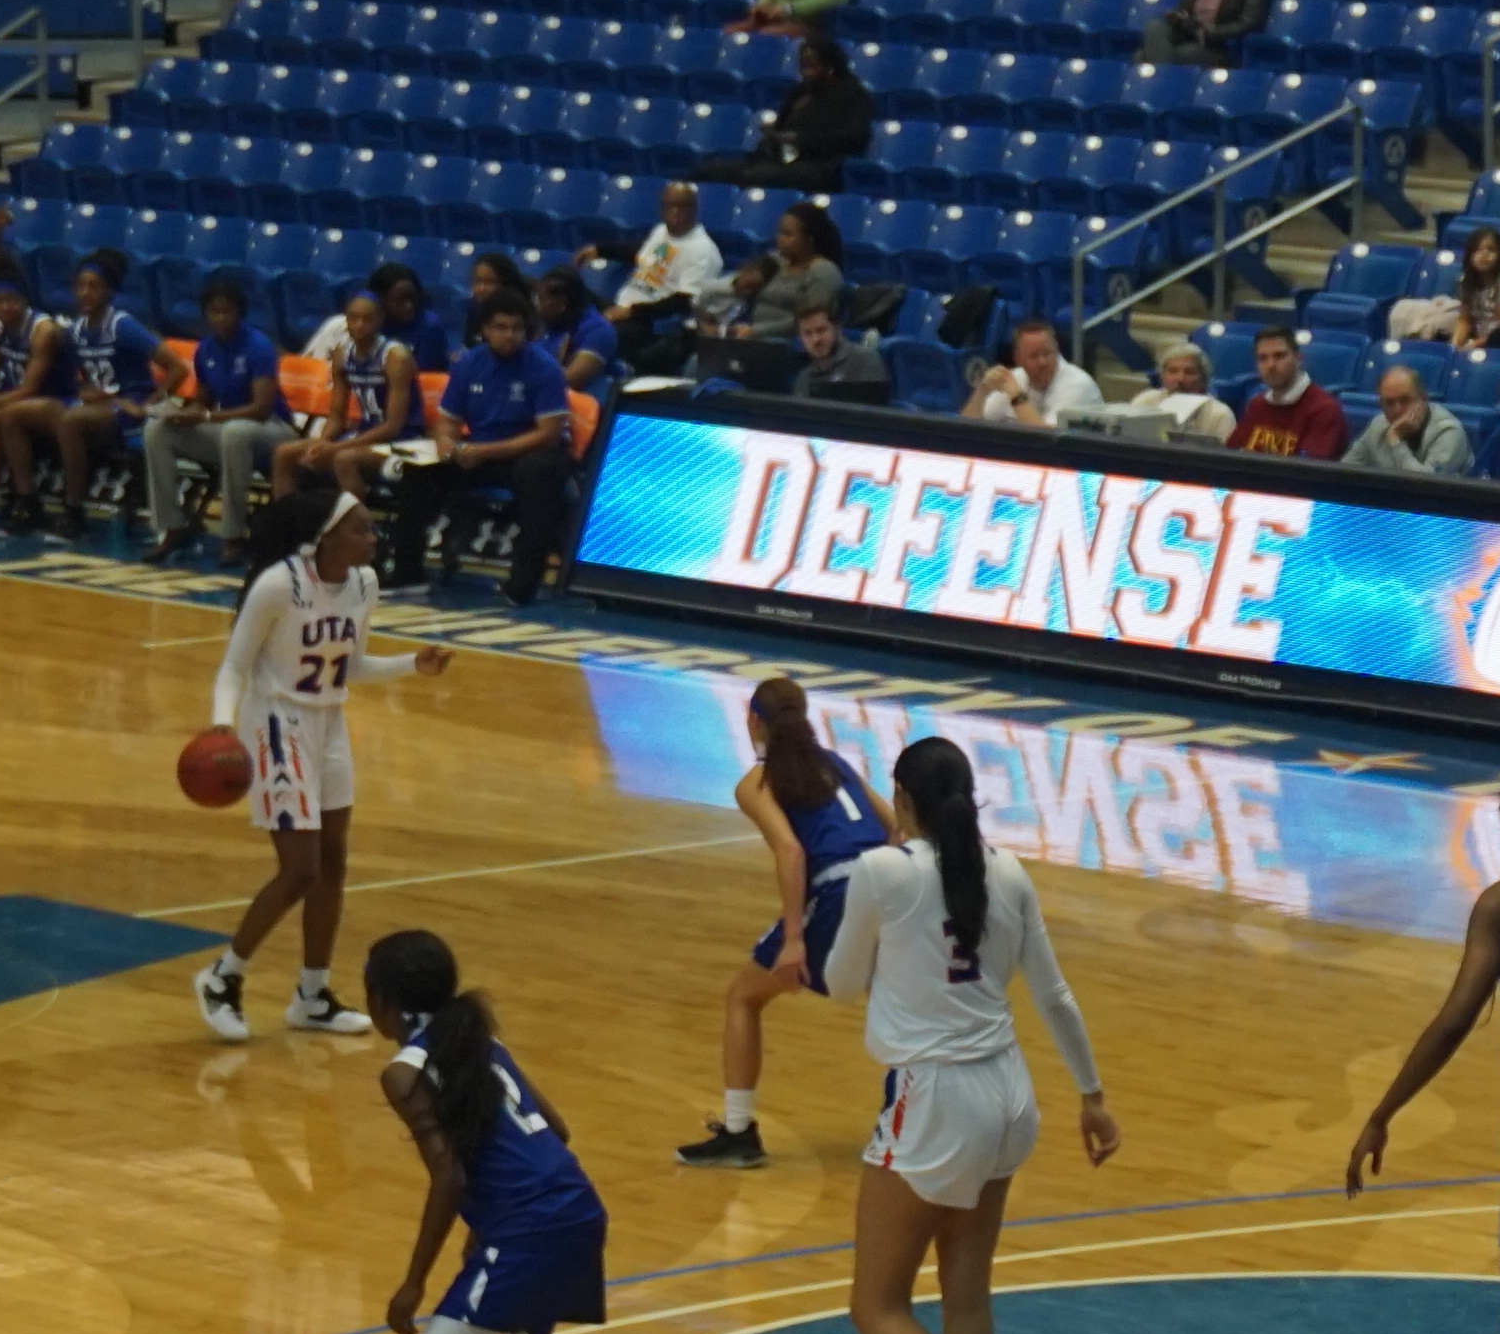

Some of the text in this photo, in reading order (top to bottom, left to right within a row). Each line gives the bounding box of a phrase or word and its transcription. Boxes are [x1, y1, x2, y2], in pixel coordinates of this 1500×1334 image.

[712, 425, 1314, 661] DEFENSE
[302, 616, 357, 647] UTA
[295, 653, 350, 695] 21
[1047, 711, 1296, 747] OF
